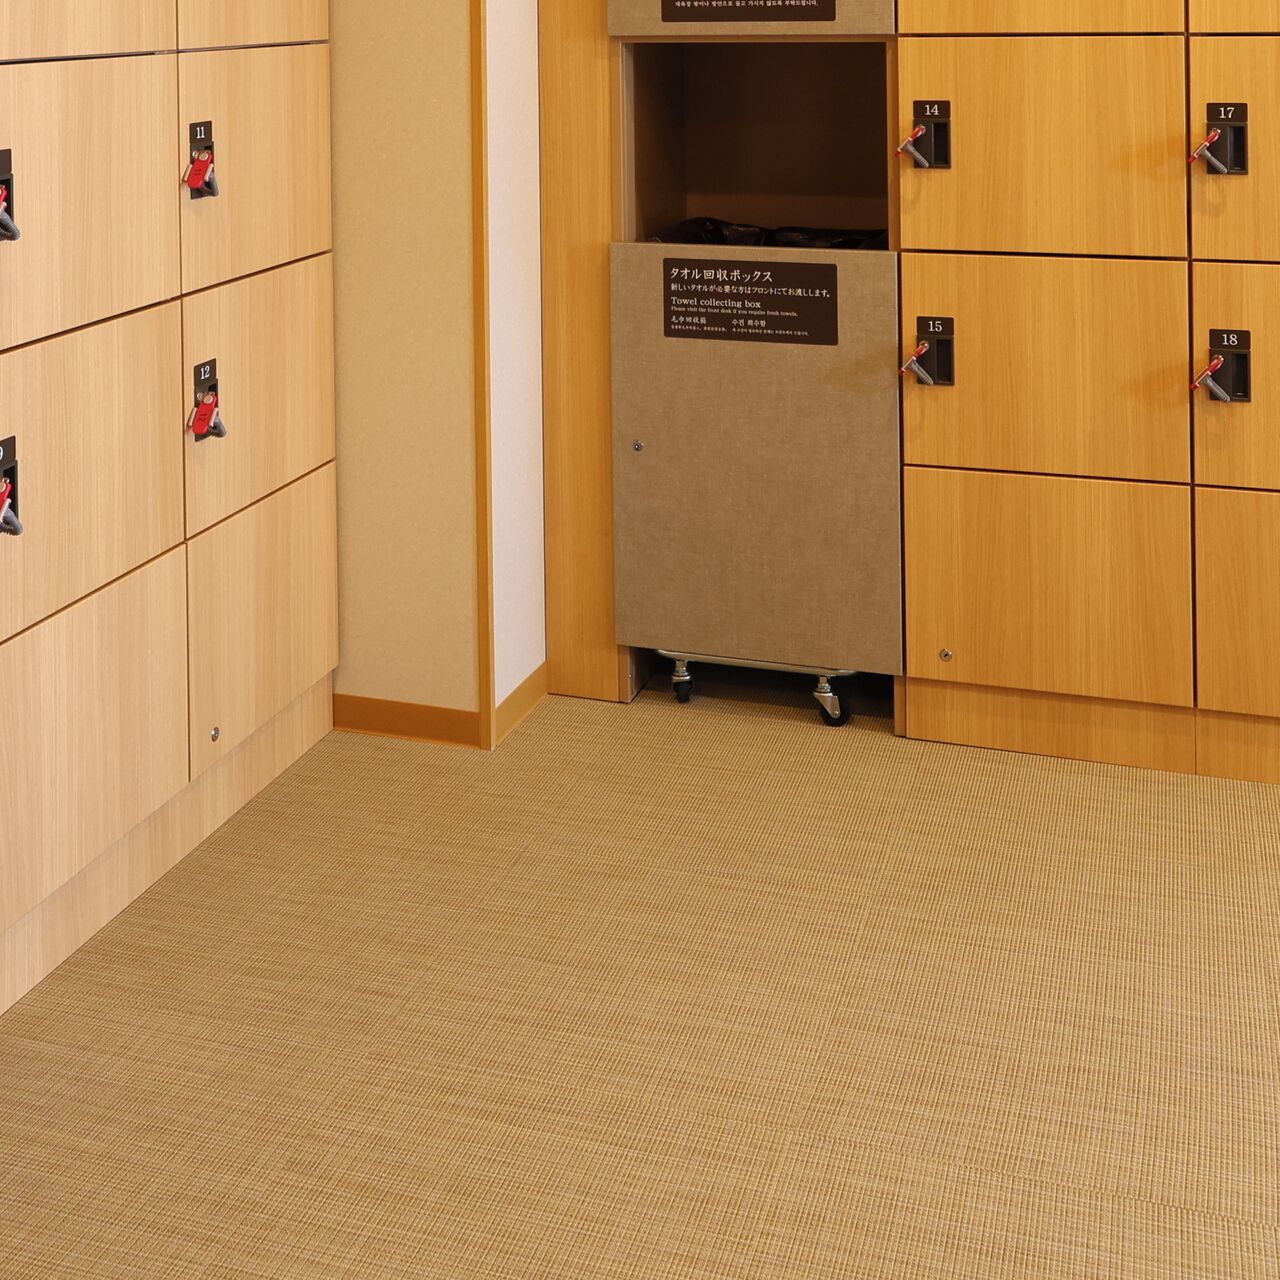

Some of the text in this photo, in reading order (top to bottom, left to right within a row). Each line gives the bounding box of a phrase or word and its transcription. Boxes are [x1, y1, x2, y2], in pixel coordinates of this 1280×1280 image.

[926, 104, 938, 116] 14
[1220, 108, 1234, 118] 17
[196, 126, 204, 138] 11
[671, 268, 772, 282] タオル回収ボックス
[671, 283, 830, 298] 新しいタオルが必要な方はフロントにてお渡しします。
[671, 297, 761, 309] Towel collecting box
[928, 322, 942, 332] 15
[1222, 334, 1238, 346] 18
[200, 365, 210, 380] 12
